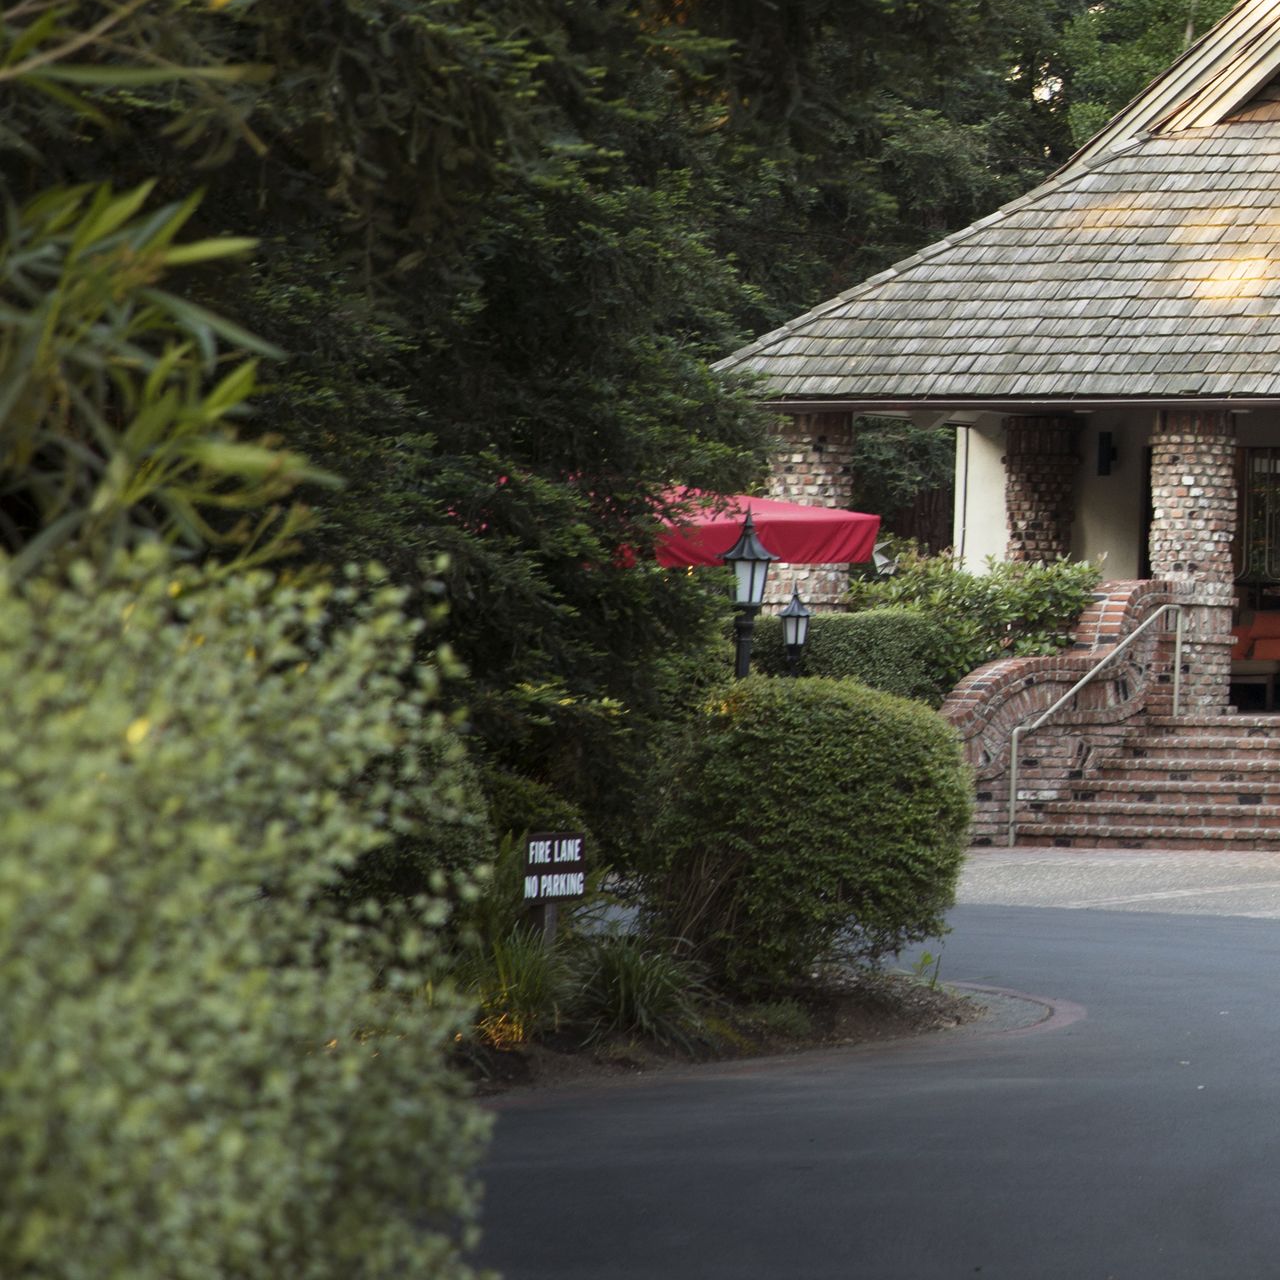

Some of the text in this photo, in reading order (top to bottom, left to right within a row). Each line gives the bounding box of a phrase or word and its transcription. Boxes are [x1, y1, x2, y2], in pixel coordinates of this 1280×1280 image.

[529, 839, 581, 864] FIRE LANE
[524, 872, 584, 898] NO PARKING
